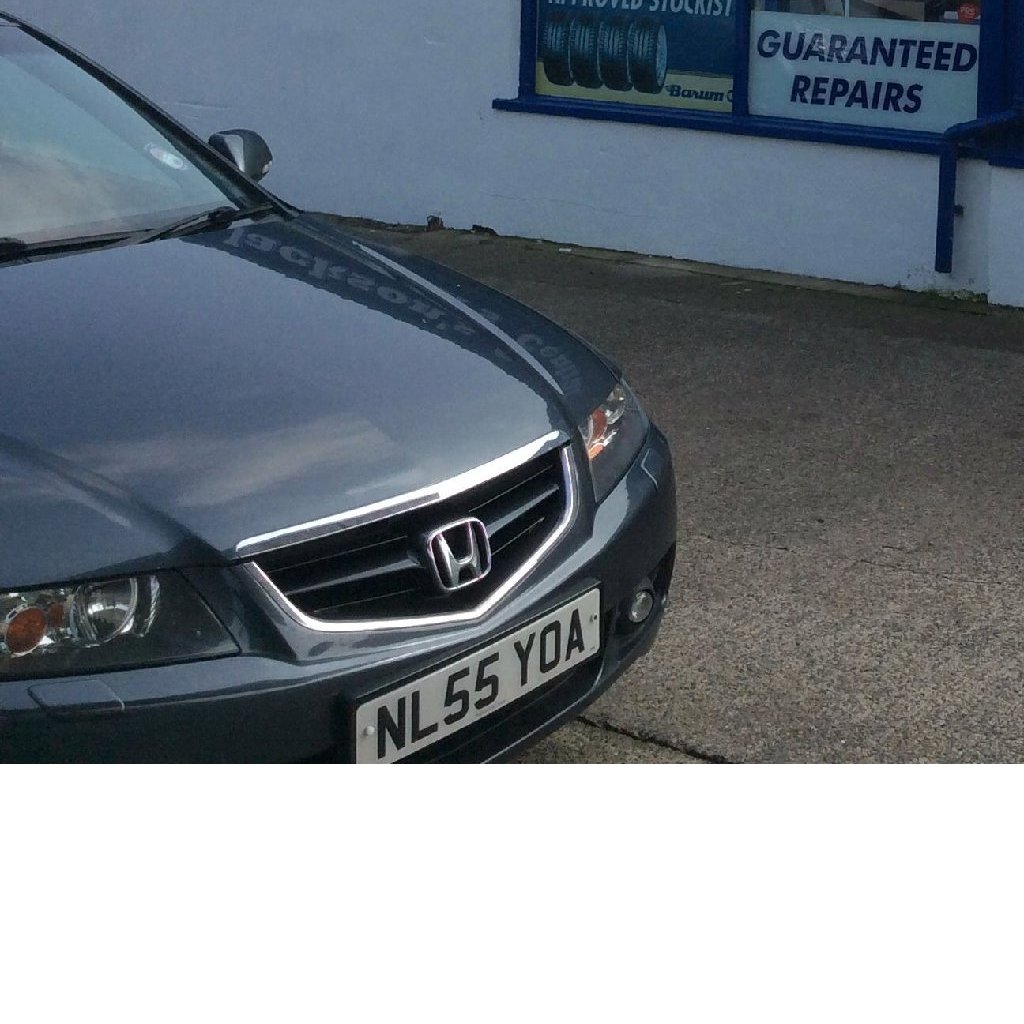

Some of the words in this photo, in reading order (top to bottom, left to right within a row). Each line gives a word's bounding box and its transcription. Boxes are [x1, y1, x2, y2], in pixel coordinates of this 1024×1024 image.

[756, 29, 978, 72] GUARANTEED
[789, 74, 924, 113] REPAIRS
[377, 652, 499, 760] NL55
[513, 608, 585, 687] YOA
